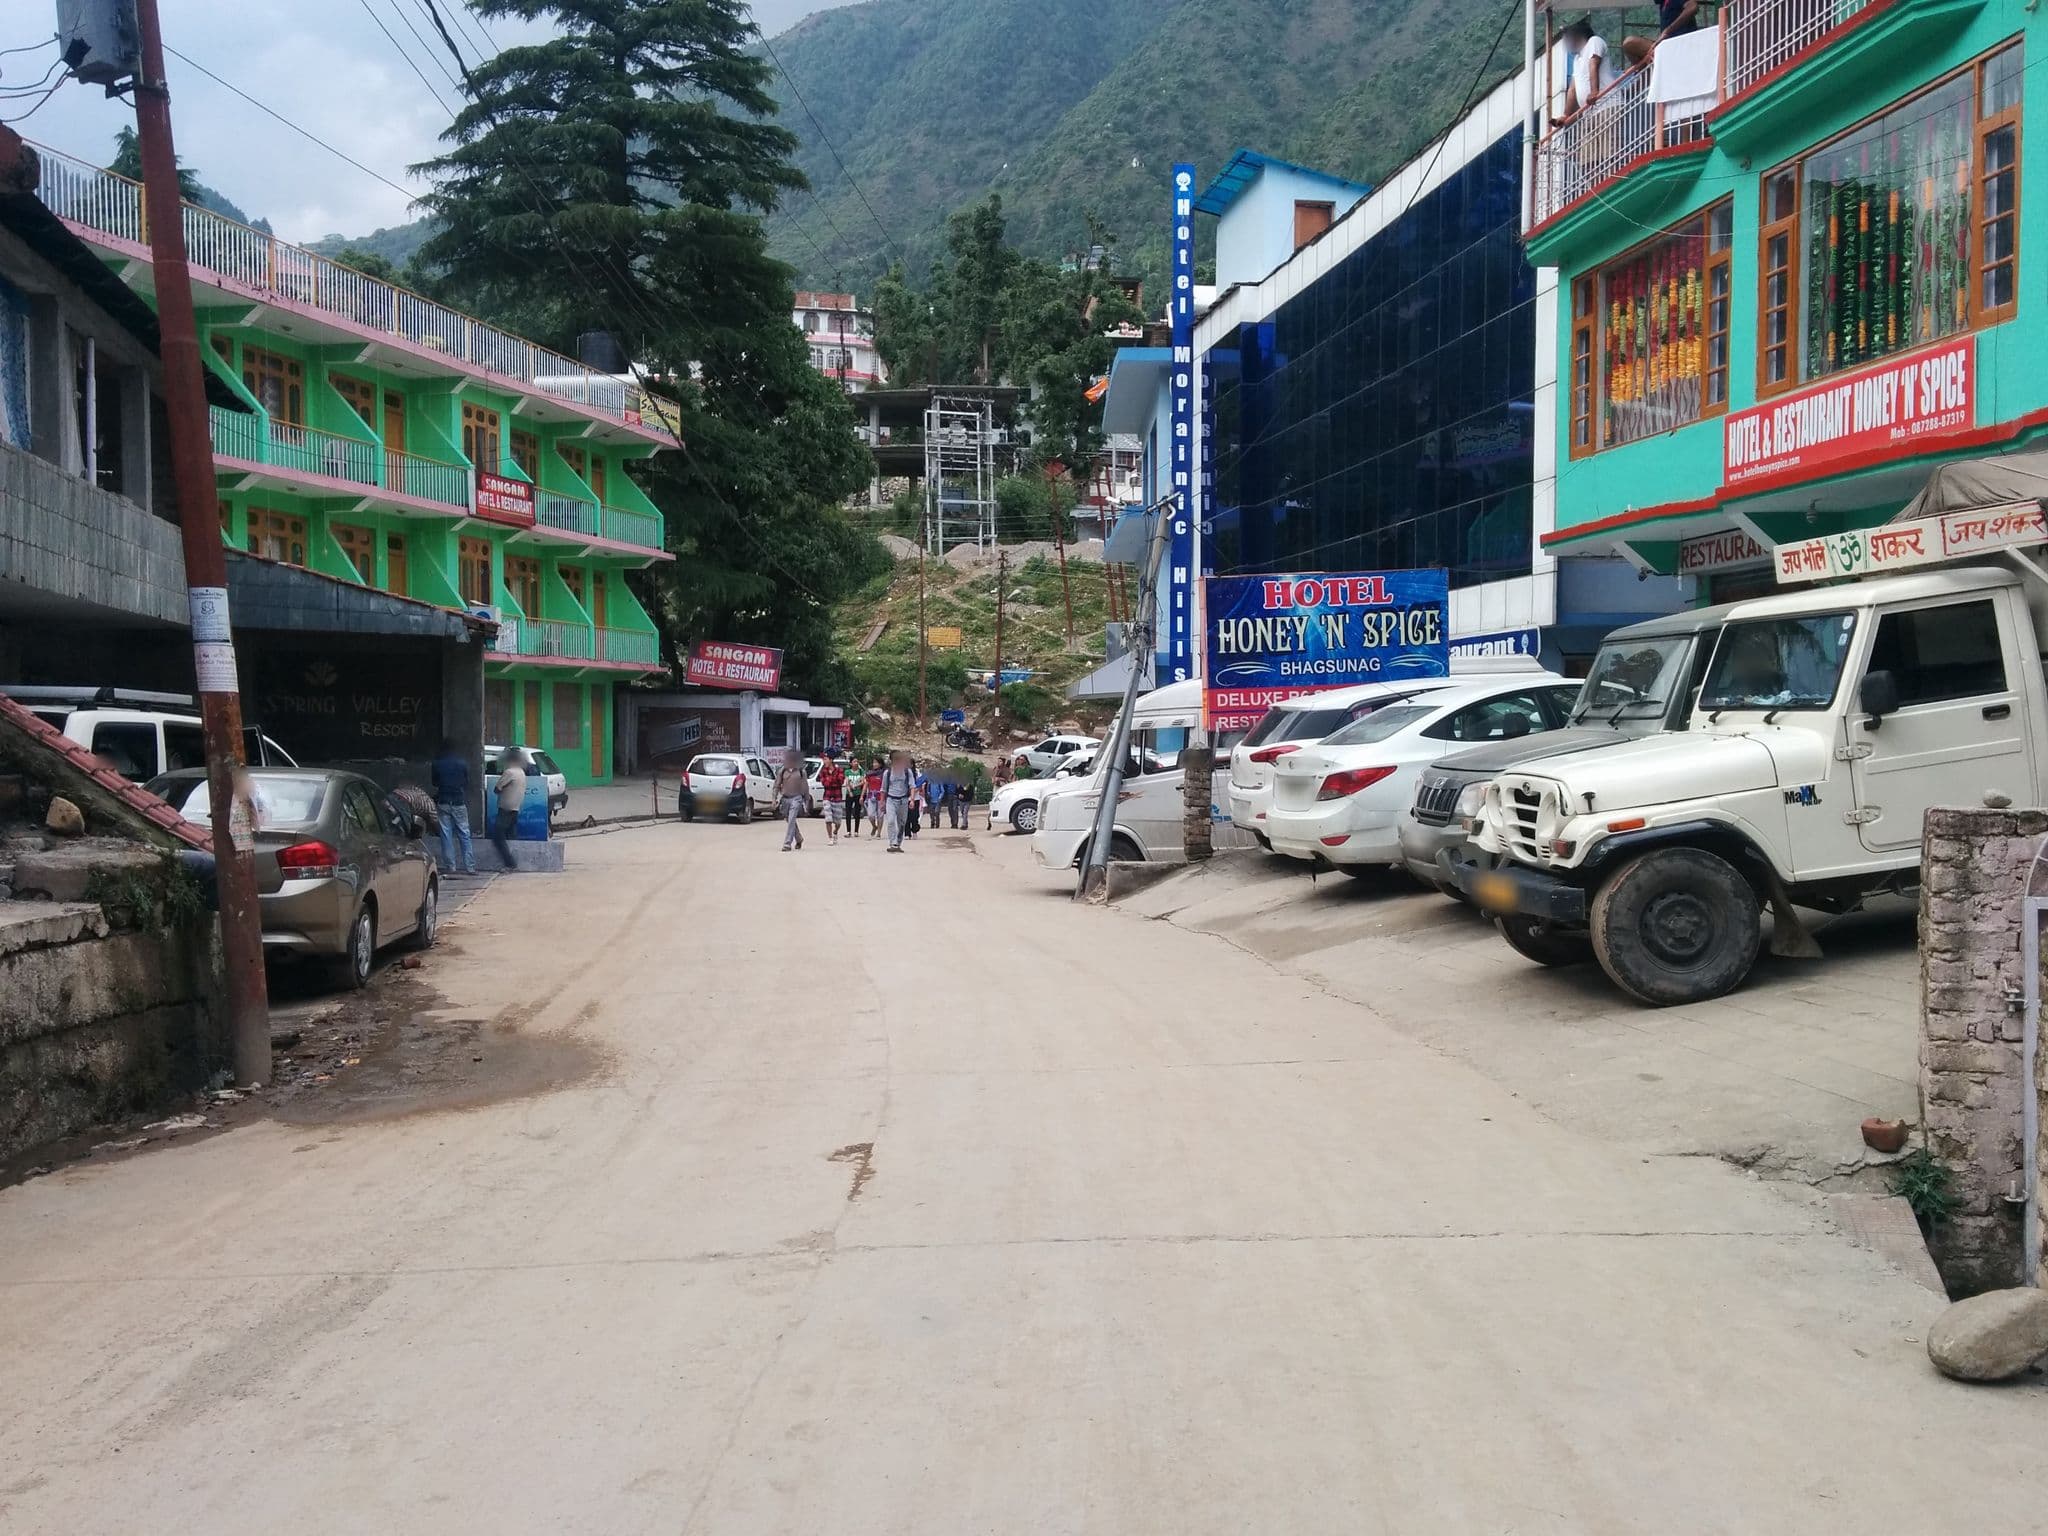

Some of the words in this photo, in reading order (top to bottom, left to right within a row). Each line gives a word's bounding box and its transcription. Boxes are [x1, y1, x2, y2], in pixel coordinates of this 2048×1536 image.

[1176, 198, 1190, 314] Hotel
[1728, 414, 1760, 468] HOTEL
[1763, 418, 1771, 459] &
[1774, 387, 1851, 455] RESTAURANT
[1854, 369, 1899, 433] HONEY
[1921, 350, 1966, 416] SPICE
[1174, 346, 1190, 535] Morainic
[485, 478, 526, 497] SANGAM
[478, 490, 495, 507] HOTEL
[501, 495, 533, 514] RESTAURANT
[1949, 519, 1987, 544] जय
[1263, 575, 1394, 609] HOTEL
[1173, 567, 1187, 682] Hills
[1218, 615, 1310, 654] HONEY
[1321, 612, 1350, 650] 'N'
[1363, 609, 1441, 648] SPICE
[705, 645, 766, 665] SANGAM
[1280, 657, 1381, 676] BHAGSUNAG
[691, 658, 716, 675] HOTEL
[717, 662, 724, 676] &
[725, 663, 775, 684] RESTAURANT
[265, 695, 336, 713] SPRING
[352, 696, 422, 713] VALLEY
[1217, 691, 1283, 707] DELUXE
[360, 721, 417, 737] RESORT
